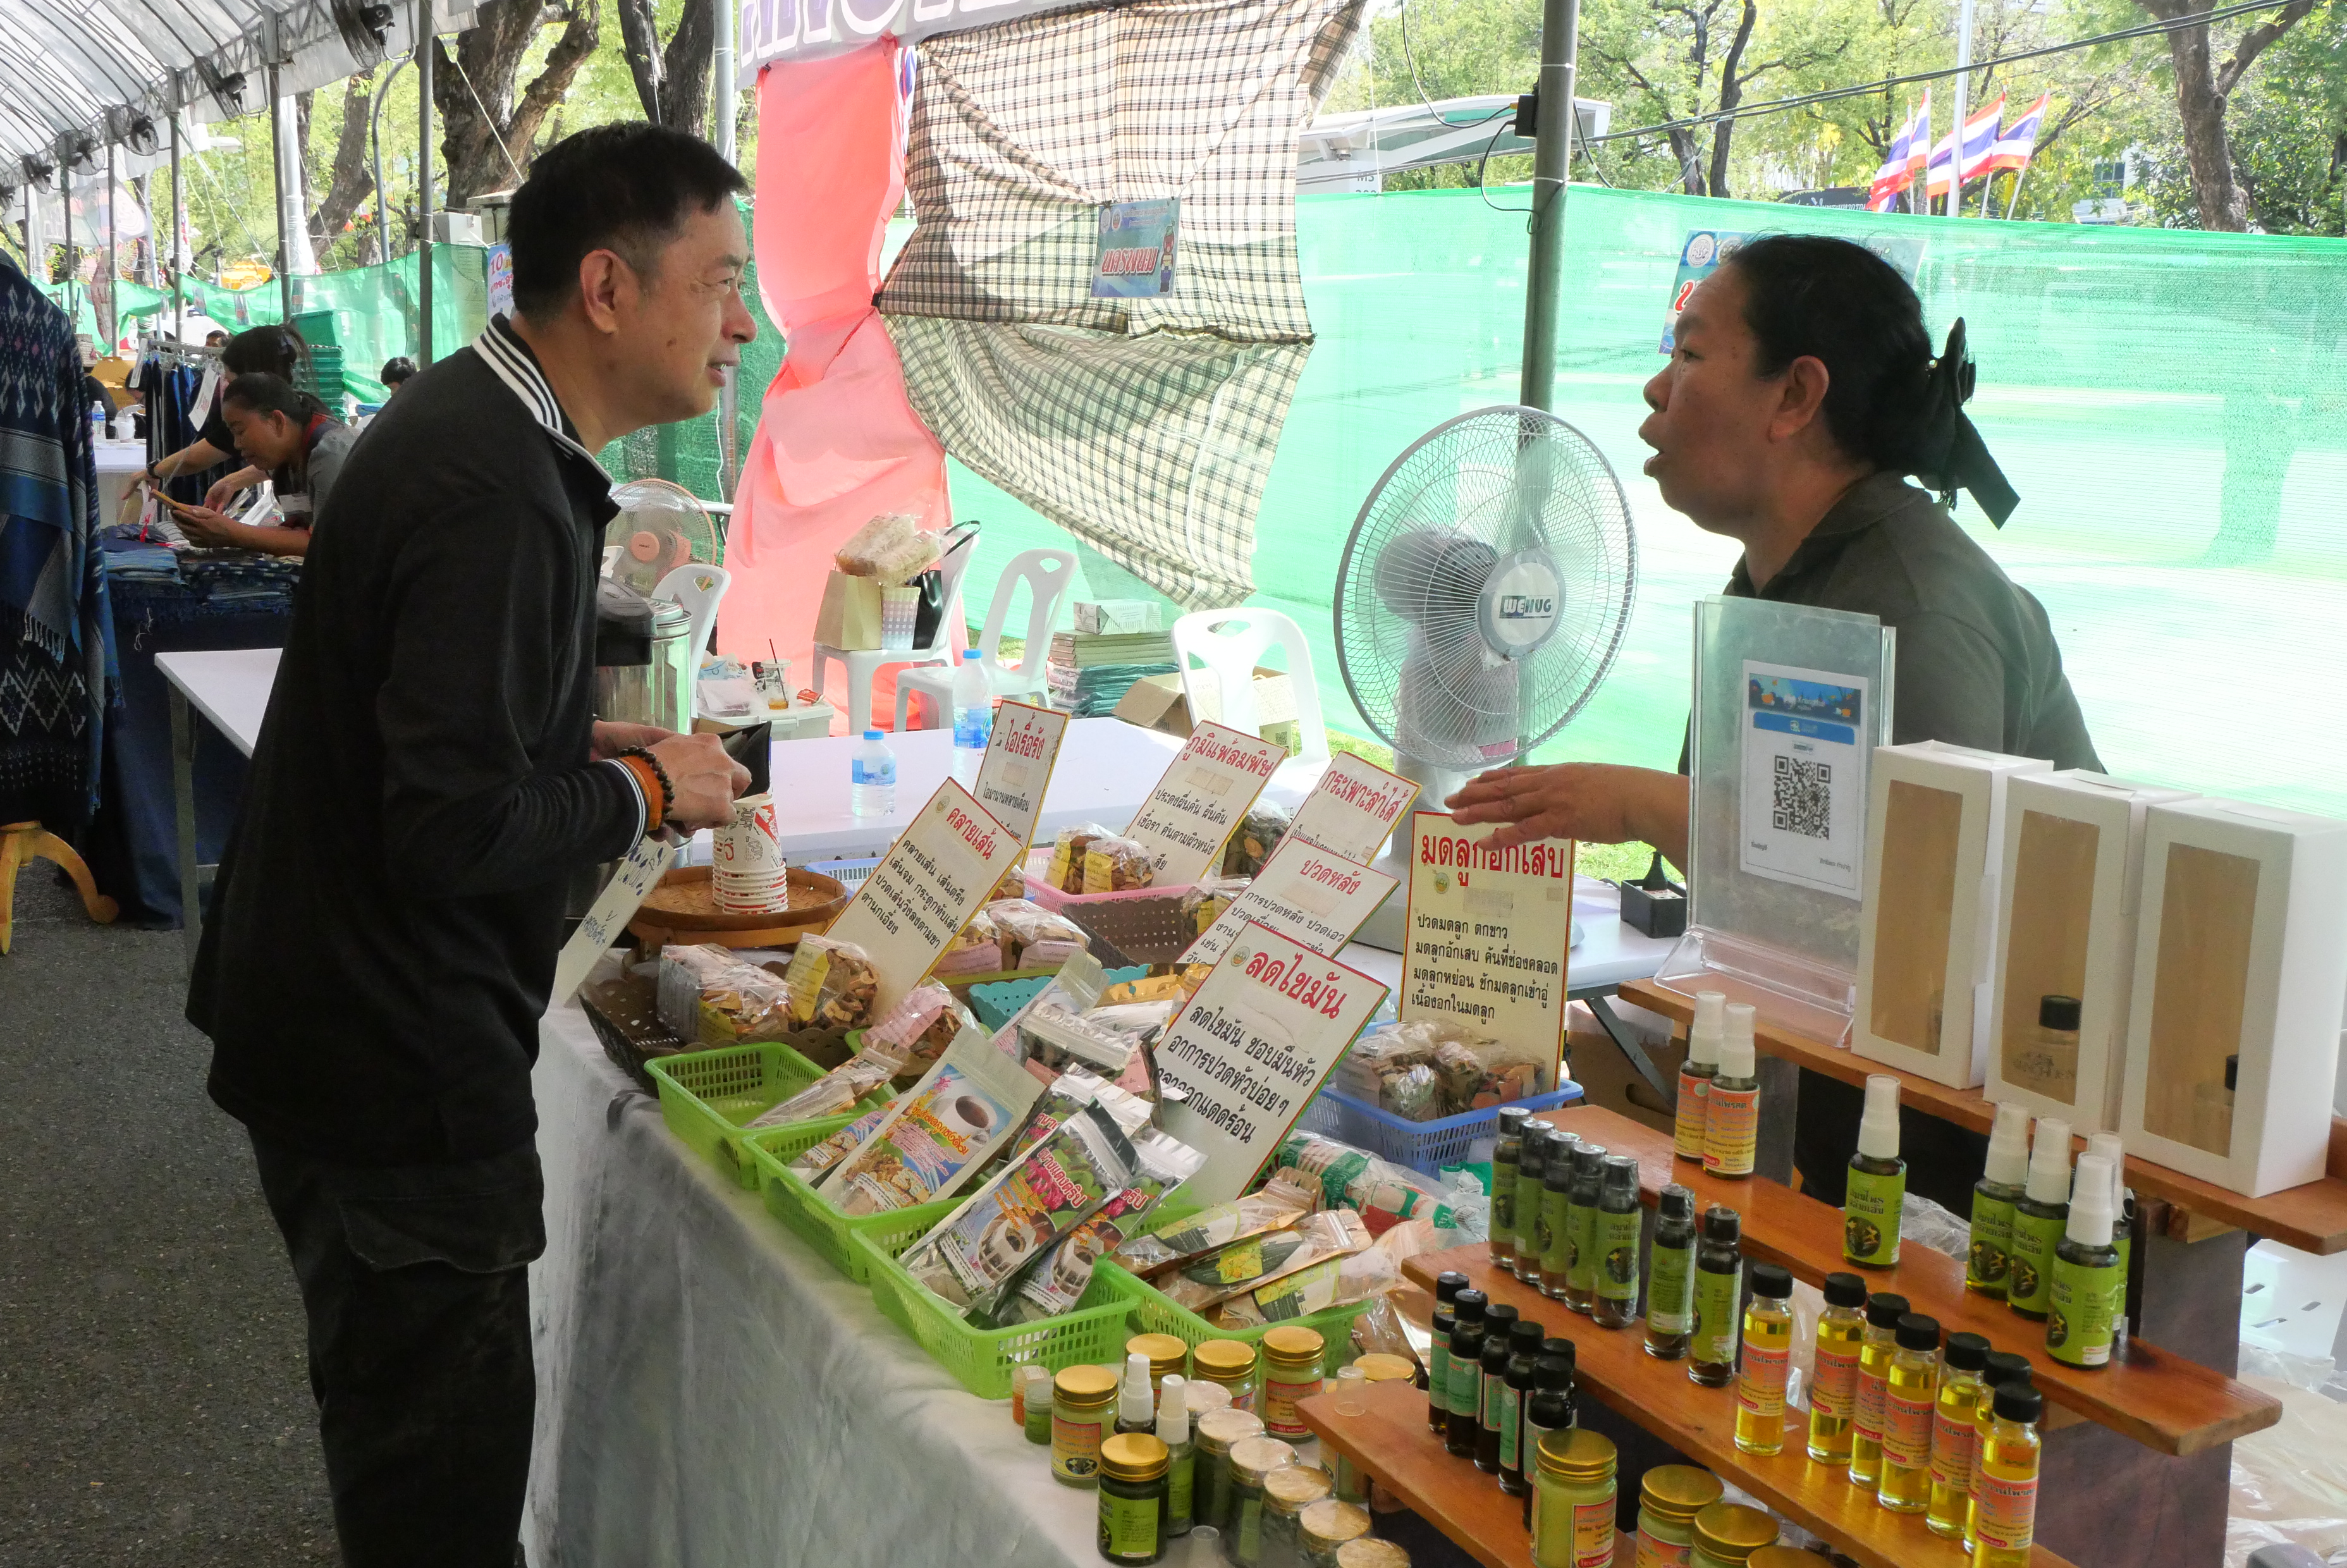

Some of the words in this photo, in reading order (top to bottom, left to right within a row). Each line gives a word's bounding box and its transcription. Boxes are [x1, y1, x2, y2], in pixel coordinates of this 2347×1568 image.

[1102, 247, 1158, 276] นครพนม
[1504, 599, 1552, 613] WEHUG
[1005, 712, 1045, 761] ไอเรื้อรัง
[1182, 732, 1275, 777] ภูมิแพ้ลมพิษ
[1155, 788, 1203, 816] ประดงผื่นคัน
[1203, 800, 1229, 826] ผื่นคัน
[1321, 770, 1409, 823] กระเพาะลำไส้
[947, 807, 998, 861] คลายเส้น
[1136, 809, 1161, 833] เชื้อรา
[1160, 822, 1215, 856] คันตามผิวหนัง
[902, 840, 937, 878] คลายเส้น
[936, 874, 965, 907] เส้นตรึง
[1299, 858, 1362, 896] ปวดหลัง
[1421, 829, 1564, 887] มดลูกอกเสบ
[861, 891, 899, 935] ตานกเอี้ยง
[875, 874, 941, 949] ปวดเส้นวิ่งลงตามขา
[888, 856, 915, 886] เส้นจม
[914, 882, 959, 936] กระดูกทับเส้น
[1244, 890, 1306, 924] การปวดหลัง
[1306, 919, 1346, 943] ปวดเอว
[1200, 937, 1220, 952] เช่น
[1417, 913, 1469, 940] ปวดมดลูก
[1474, 924, 1508, 940] ตกขาว
[1415, 940, 1480, 963] มดลูกอักเสบ
[1485, 943, 1559, 976] คันที่ช่องคลอด
[1245, 950, 1348, 1020] ลดไขมัน
[1411, 983, 1495, 1026] เนื้องอกในมดลูก
[1413, 967, 1475, 990] มดลูกหย่อน
[1479, 976, 1549, 1008] ชักมดลูกเข้าอู่
[1189, 1005, 1247, 1048] ลดไขมัน
[1244, 1033, 1316, 1088] ชอบมึนหัว
[1167, 1034, 1279, 1112] อาการปวดหัวบ่อย
